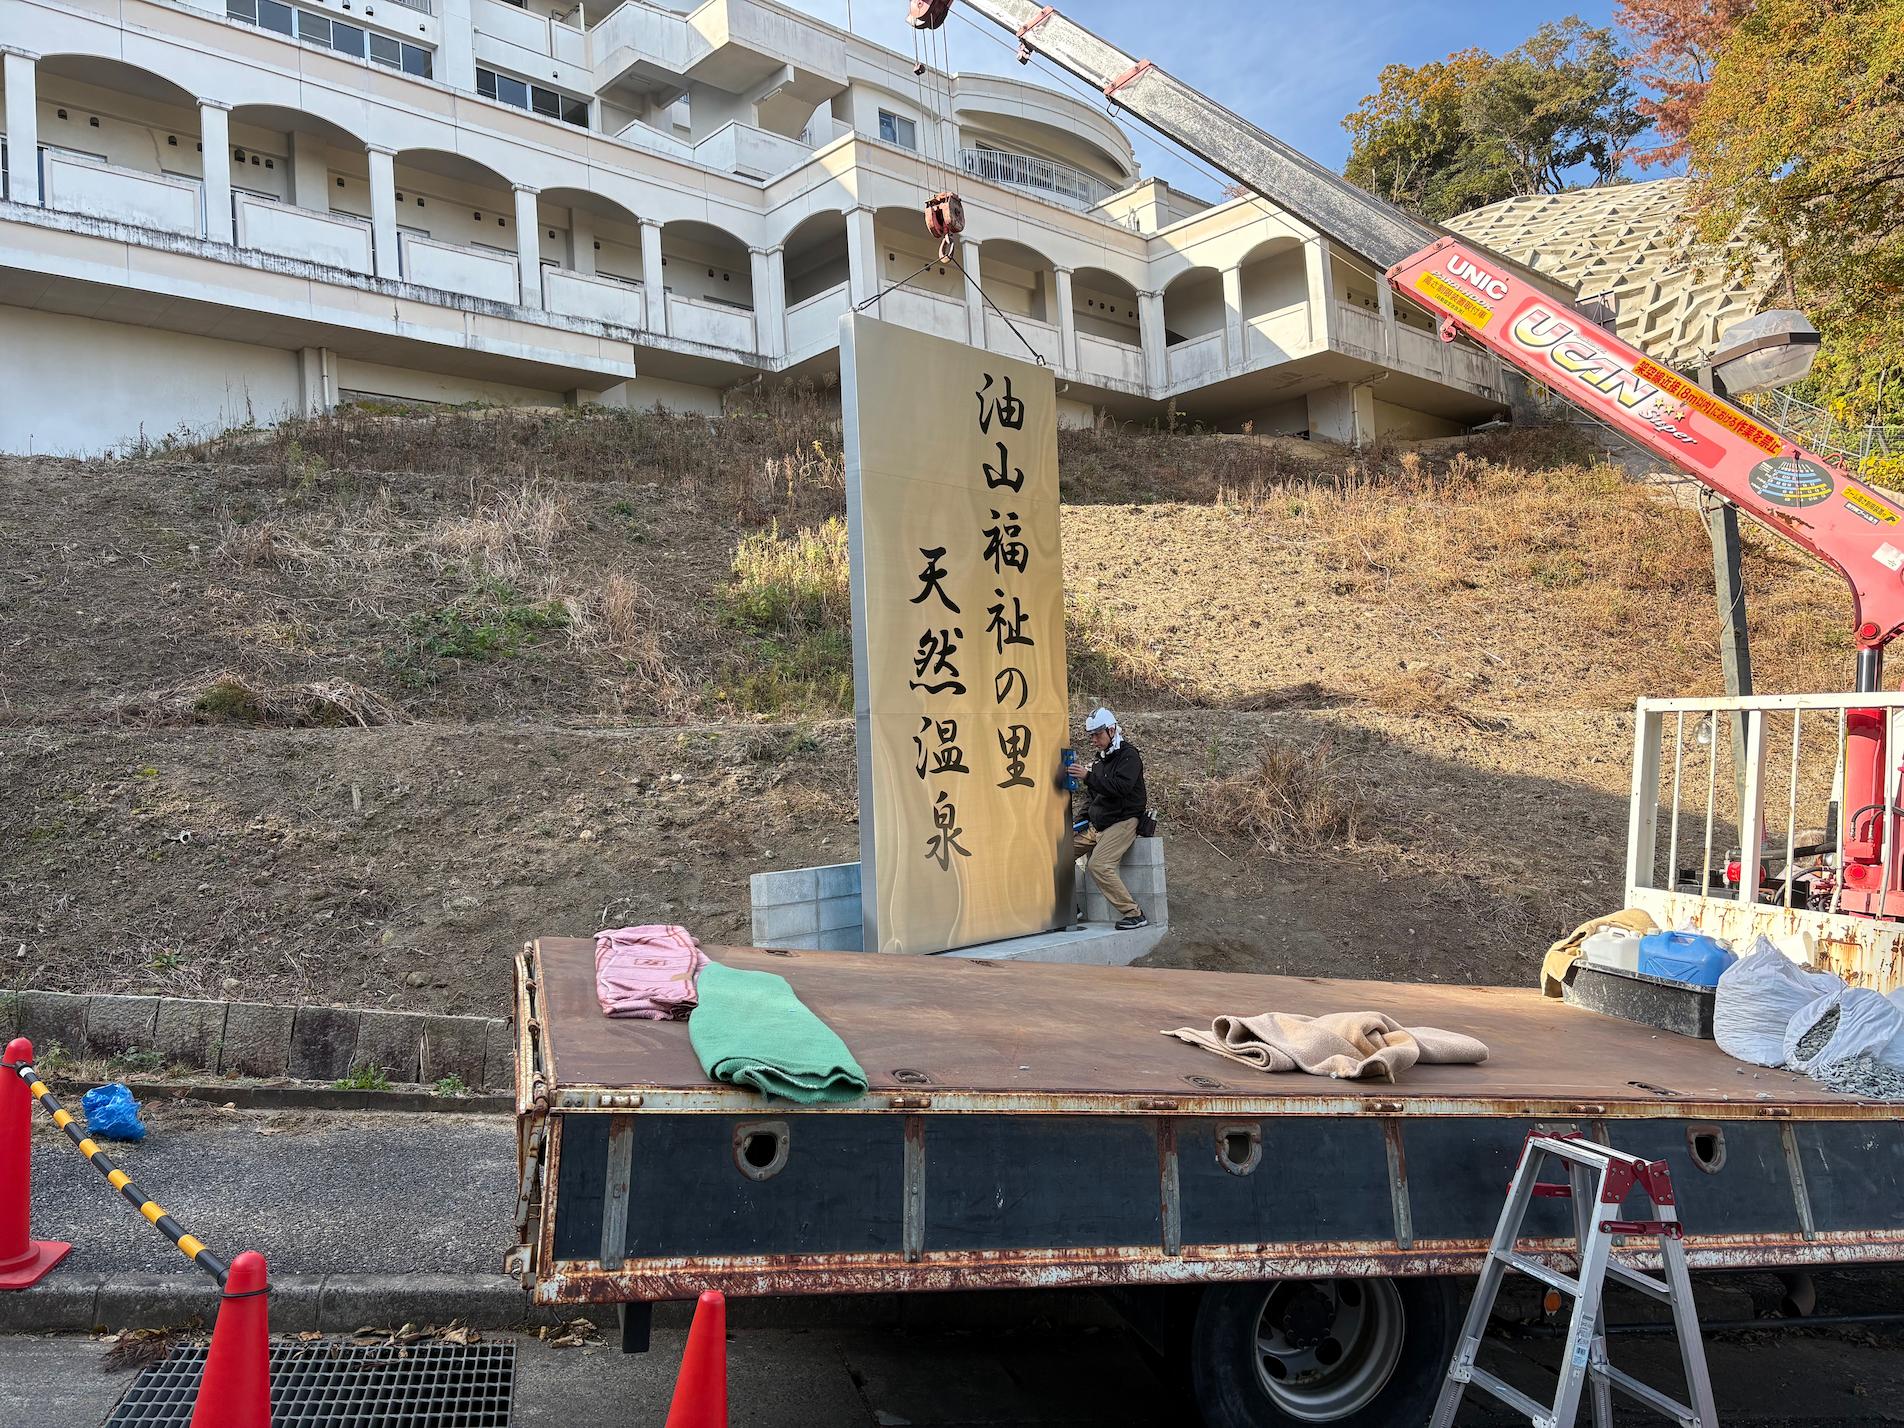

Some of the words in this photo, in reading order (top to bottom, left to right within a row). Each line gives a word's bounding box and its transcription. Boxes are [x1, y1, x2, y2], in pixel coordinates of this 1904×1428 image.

[1446, 254, 1509, 301] UNIC
[1514, 308, 1659, 409] UCAN
[1639, 408, 1699, 445] Super
[976, 372, 1035, 789] 油山福祉の里
[909, 546, 972, 872] 天然温泉
